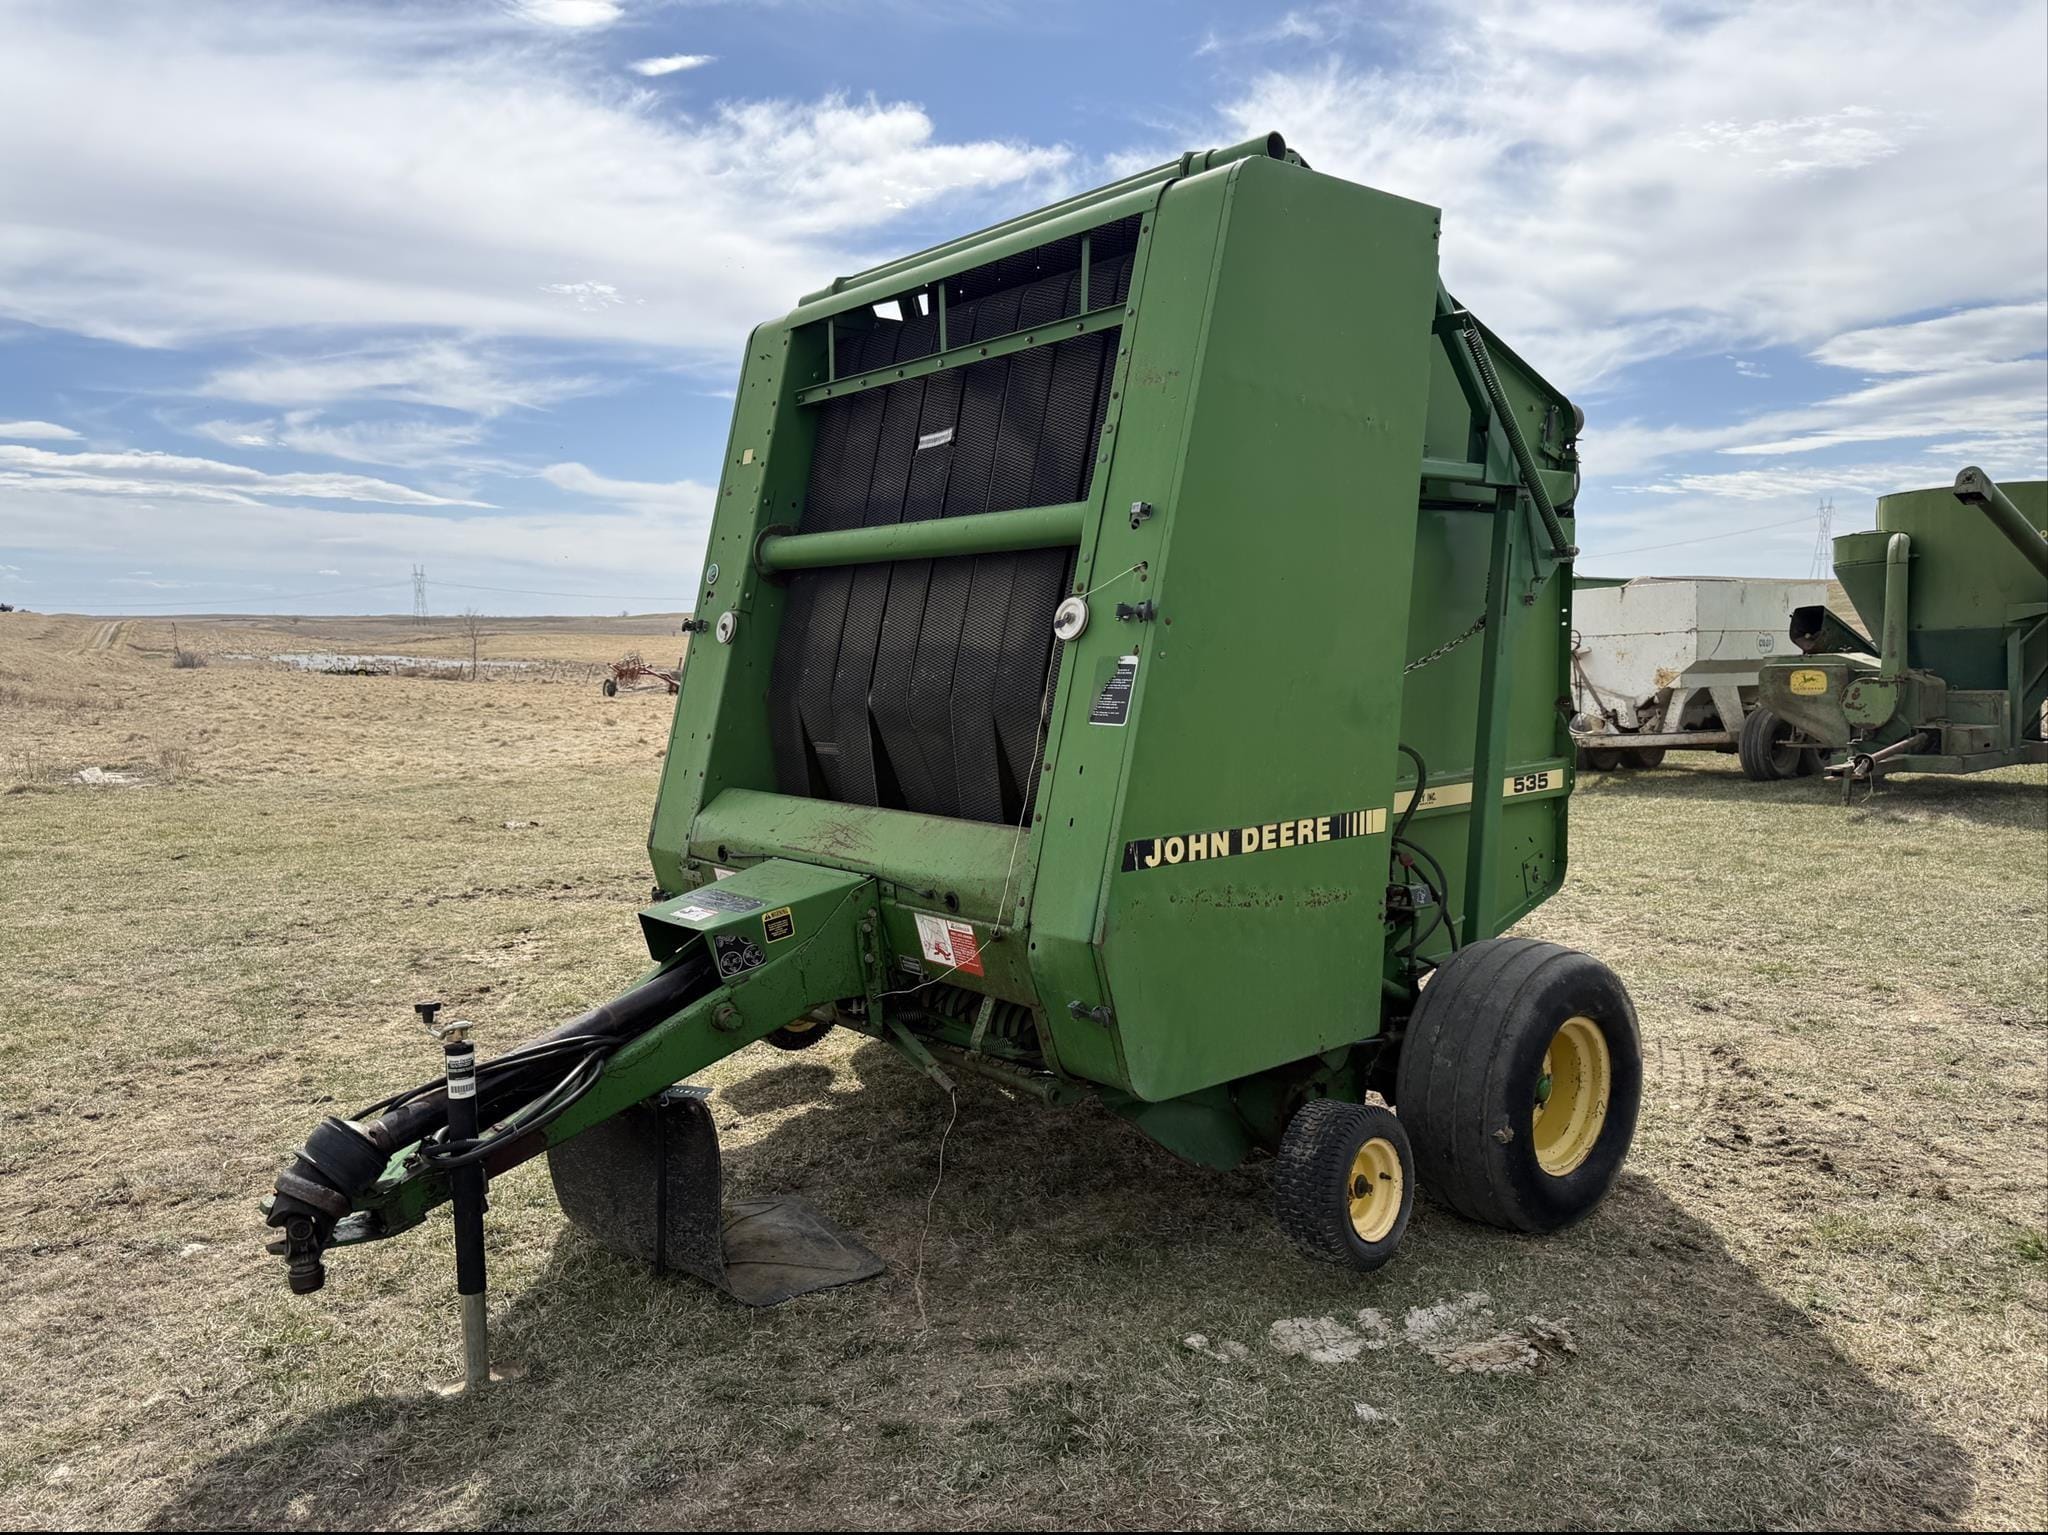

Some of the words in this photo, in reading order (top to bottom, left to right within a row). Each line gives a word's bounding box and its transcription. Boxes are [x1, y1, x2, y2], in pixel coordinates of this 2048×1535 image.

[1513, 773, 1549, 793] 535
[1145, 831, 1230, 868] JOHN
[1241, 816, 1331, 854] DEERE
